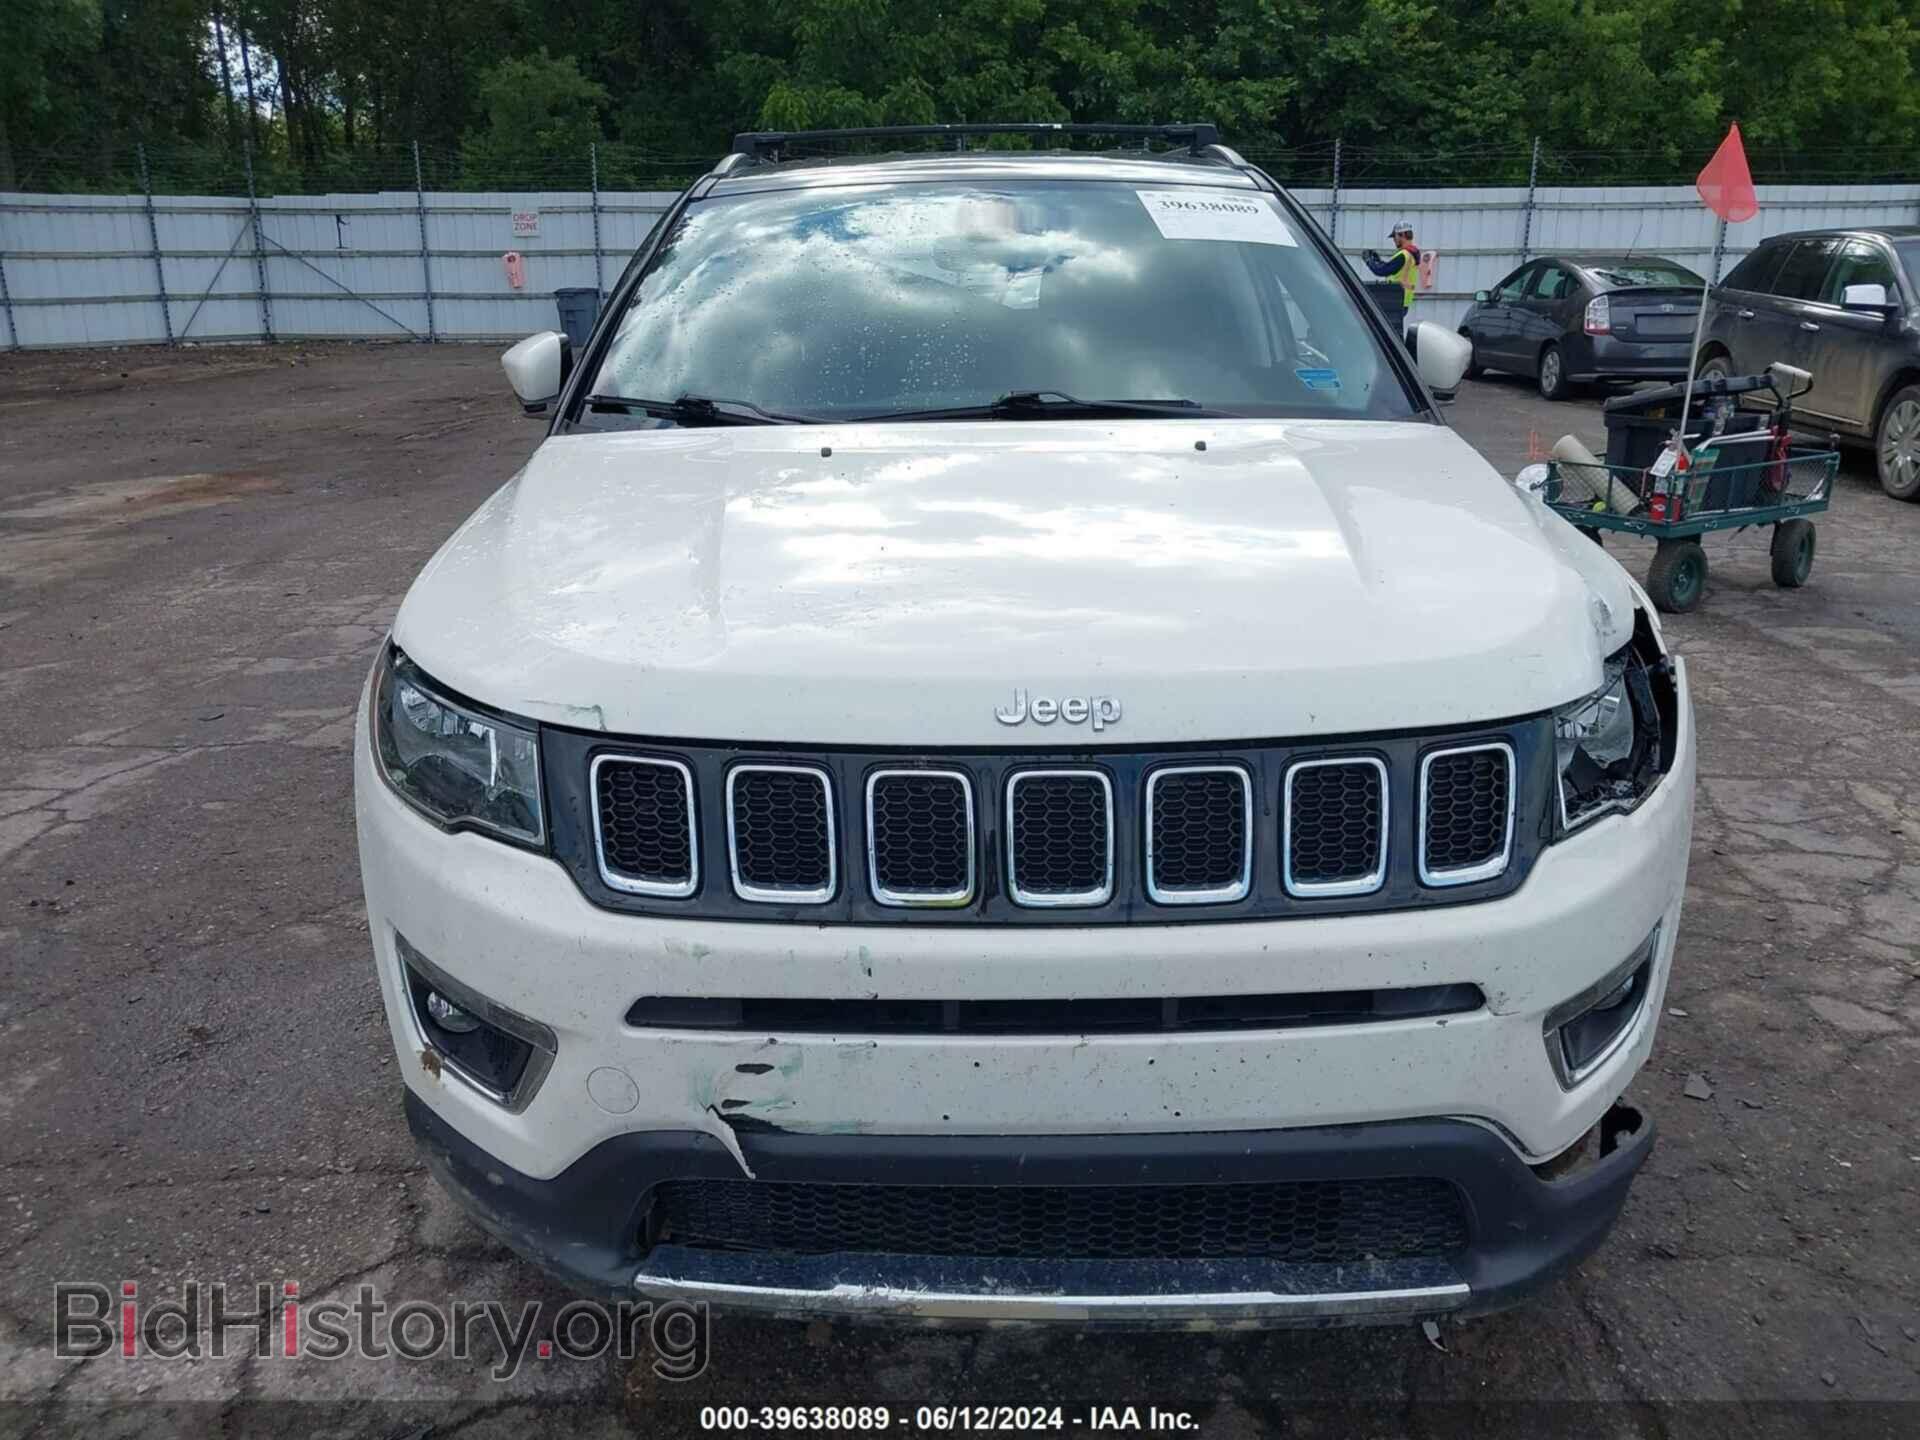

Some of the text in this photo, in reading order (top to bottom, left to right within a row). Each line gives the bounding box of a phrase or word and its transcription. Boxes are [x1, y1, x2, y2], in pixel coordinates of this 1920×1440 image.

[1159, 200, 1259, 214] 39638089
[513, 213, 538, 221] DROP
[513, 223, 537, 231] ZONE
[995, 688, 1121, 732] Jeep
